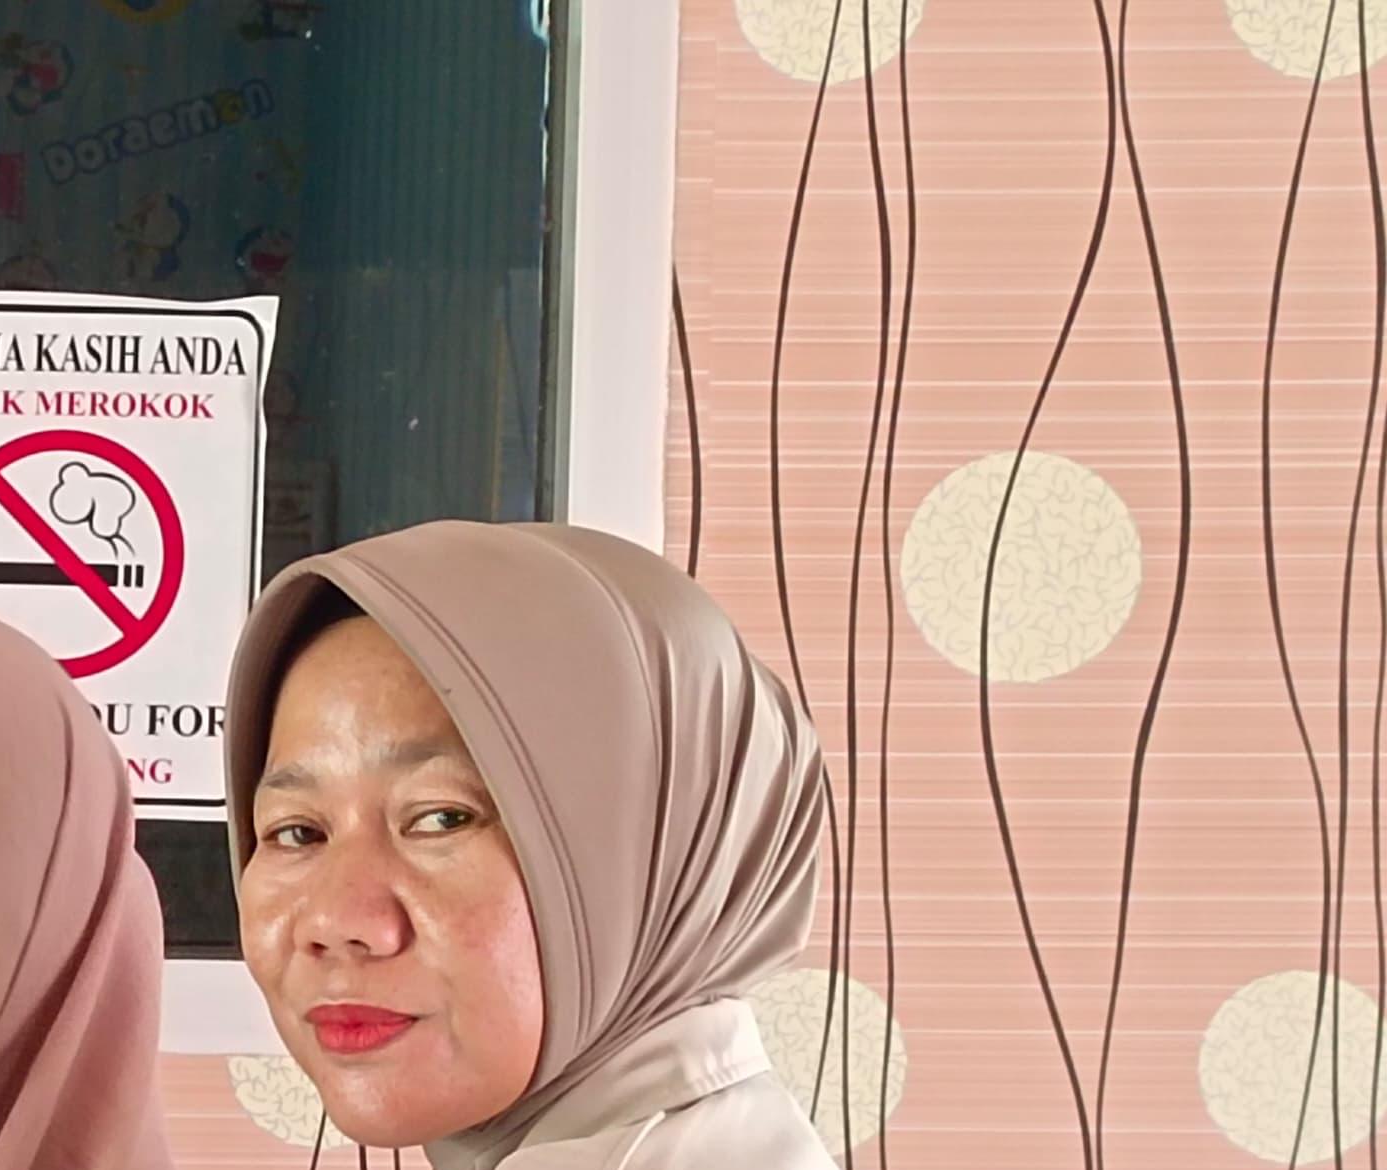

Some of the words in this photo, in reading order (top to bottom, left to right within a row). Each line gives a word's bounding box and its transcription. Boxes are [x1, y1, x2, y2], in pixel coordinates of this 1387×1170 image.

[33, 334, 142, 375] KASIH
[149, 336, 247, 376] ANDA
[34, 391, 215, 419] MEROKOK
